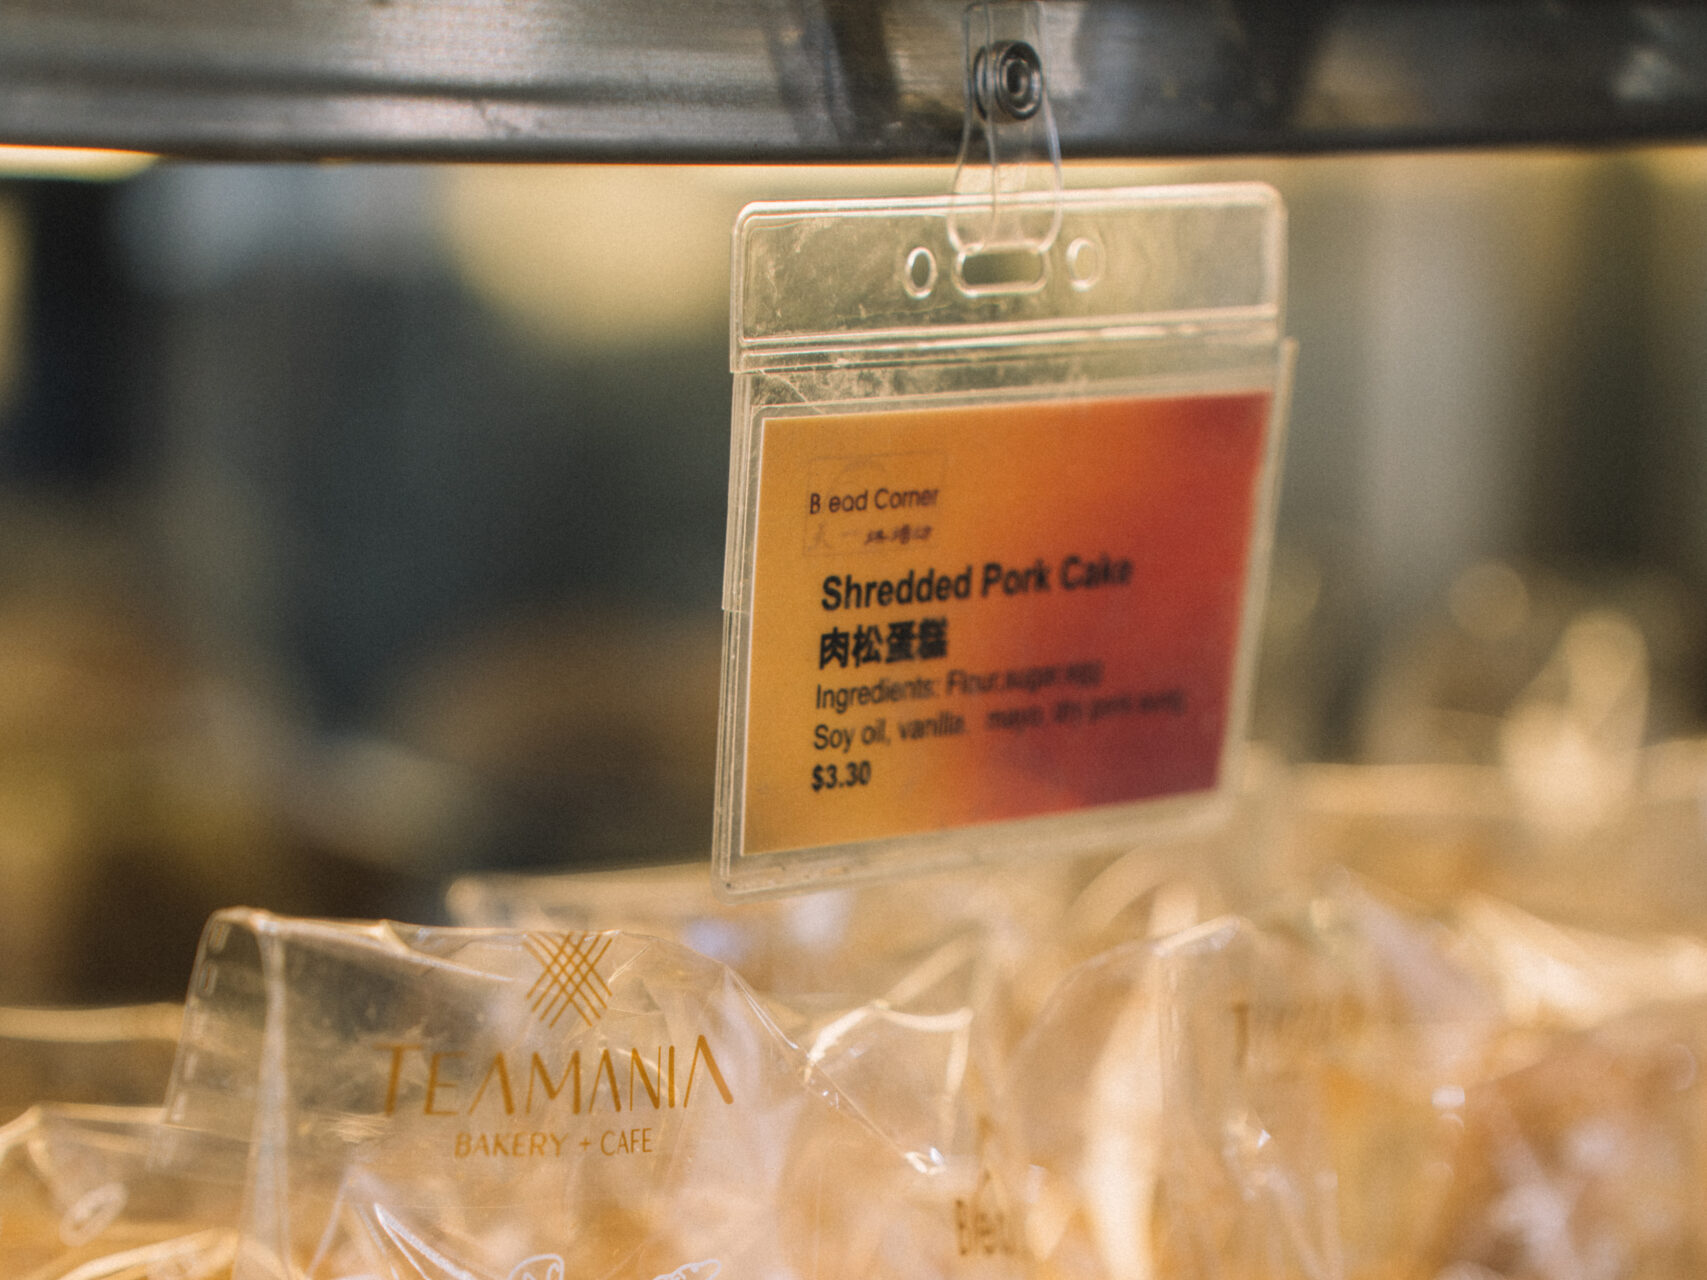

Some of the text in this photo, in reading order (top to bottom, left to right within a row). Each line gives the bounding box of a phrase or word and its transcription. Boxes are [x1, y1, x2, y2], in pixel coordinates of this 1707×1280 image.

[808, 487, 939, 515] Bead Corner
[821, 553, 1135, 611] Shredded Pork Cake
[813, 723, 856, 754] Soy
[811, 760, 872, 793] $3.30
[374, 1034, 735, 1117] TEAMANIA
[454, 1131, 569, 1158] BAKERY
[600, 1127, 654, 1156] CAFE
